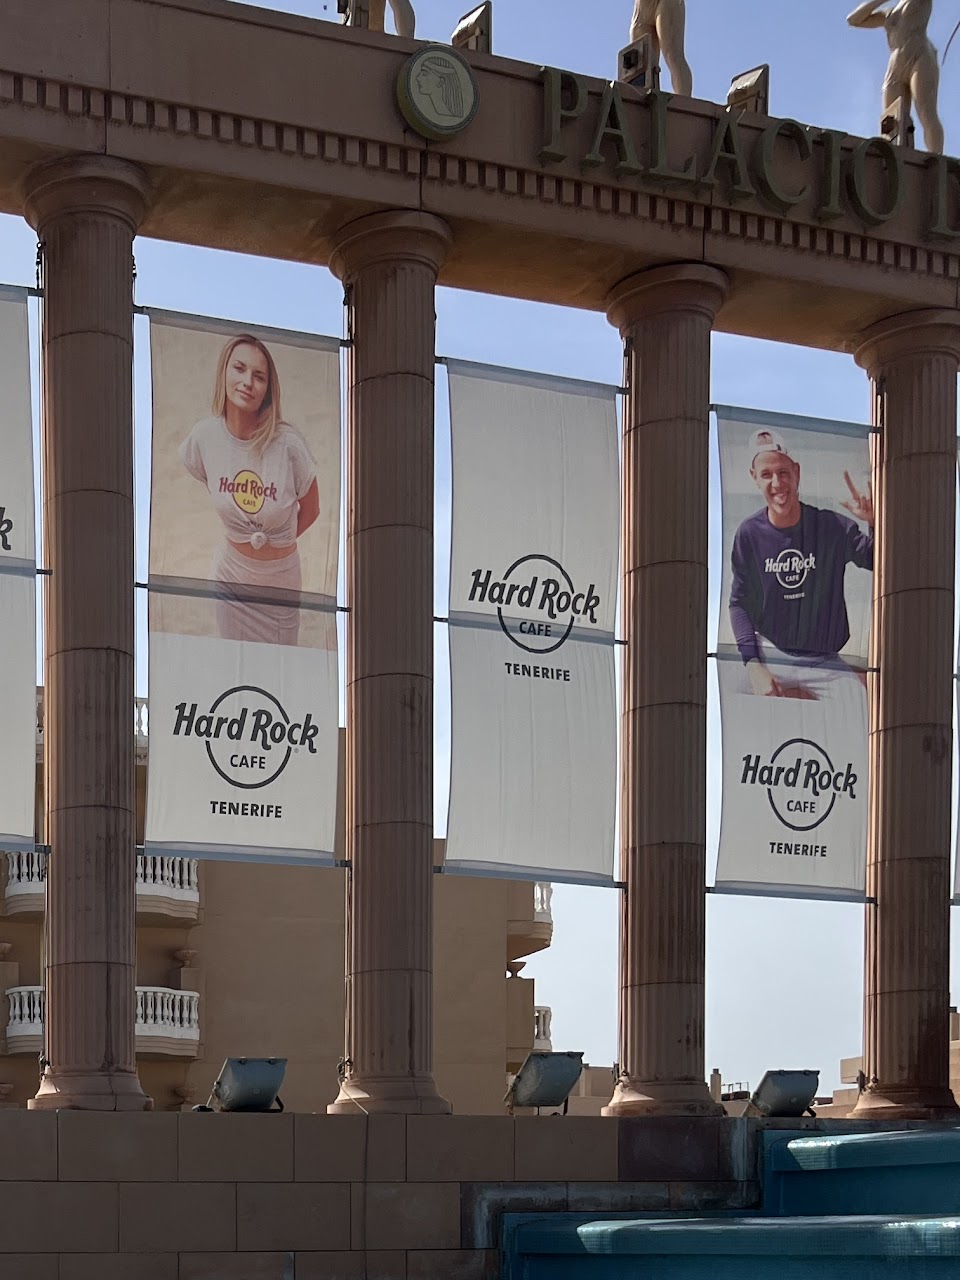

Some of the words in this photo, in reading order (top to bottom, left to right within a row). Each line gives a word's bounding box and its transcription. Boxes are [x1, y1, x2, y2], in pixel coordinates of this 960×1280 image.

[537, 65, 904, 226] PALACIO
[219, 476, 248, 493] Hard
[249, 480, 278, 501] Rock
[764, 558, 790, 572] Hard
[791, 552, 816, 573] Rock
[785, 574, 800, 582] CAFE
[468, 568, 538, 608] Hard
[538, 578, 600, 624] Rock
[519, 621, 552, 637] CAFE
[504, 662, 571, 682] TENERIFE
[173, 702, 248, 741] Hard
[250, 709, 319, 754] Rock
[230, 754, 266, 769] CAFE
[740, 754, 802, 788] Hard
[803, 759, 858, 799] Rock
[210, 800, 282, 818] TENERIFE
[786, 800, 816, 813] CAFE
[769, 841, 827, 857] TENERIFE
